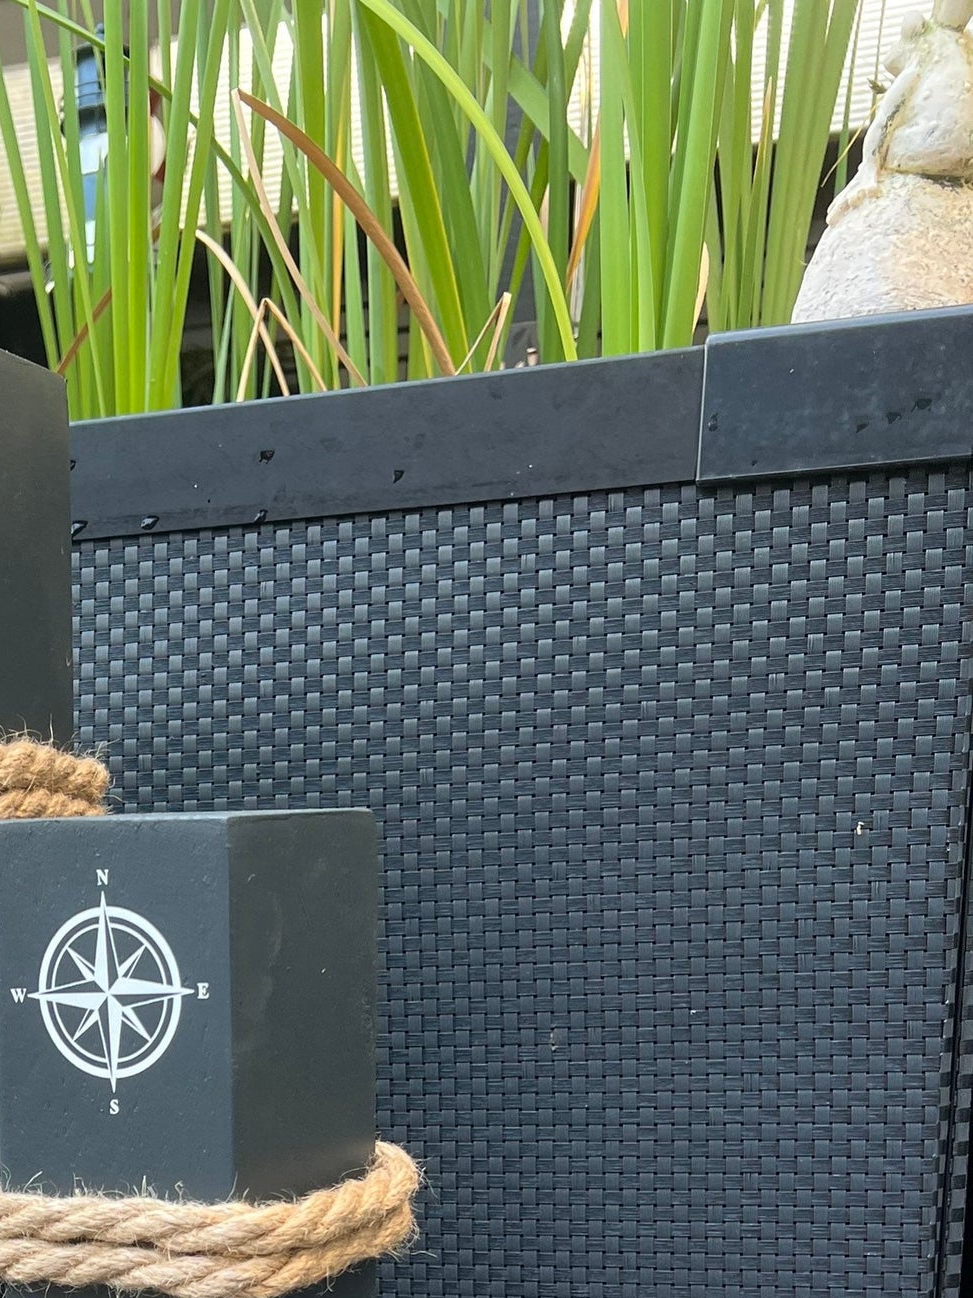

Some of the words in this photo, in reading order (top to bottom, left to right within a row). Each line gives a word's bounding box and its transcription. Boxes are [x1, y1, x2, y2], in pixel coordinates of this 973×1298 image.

[96, 868, 110, 887] N
[9, 987, 27, 1004] W
[196, 982, 210, 1000] E
[109, 1098, 120, 1115] S
